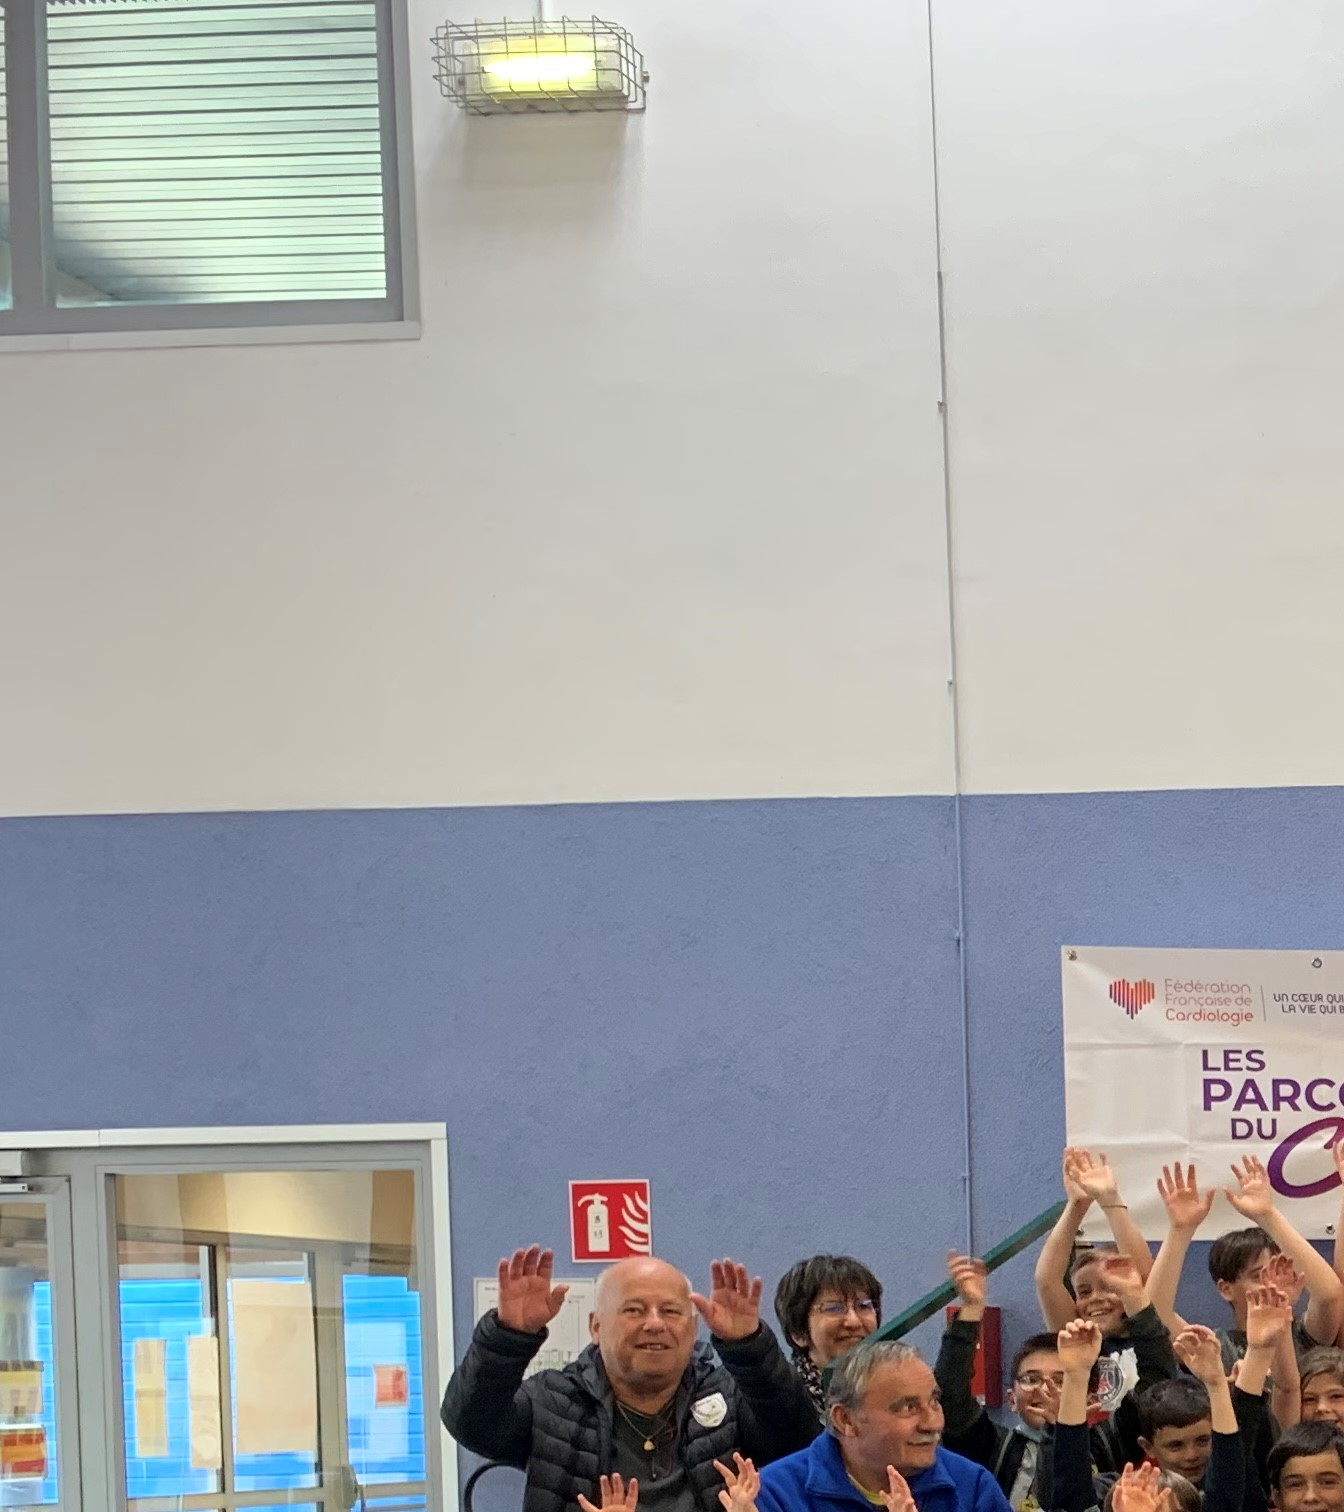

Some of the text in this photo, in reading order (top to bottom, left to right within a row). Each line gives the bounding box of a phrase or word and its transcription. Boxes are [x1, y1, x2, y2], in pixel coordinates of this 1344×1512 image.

[1164, 978, 1251, 994] Fédération
[1165, 993, 1253, 1008] Française de
[1273, 993, 1290, 1003] UN
[1326, 994, 1344, 1004] QUI
[1165, 1008, 1254, 1026] Cardiologie
[1281, 1004, 1296, 1014] LA
[1300, 1004, 1317, 1014] VIE
[1319, 1004, 1337, 1015] QUI
[1201, 1049, 1266, 1072] LES
[1230, 1117, 1278, 1141] DU
